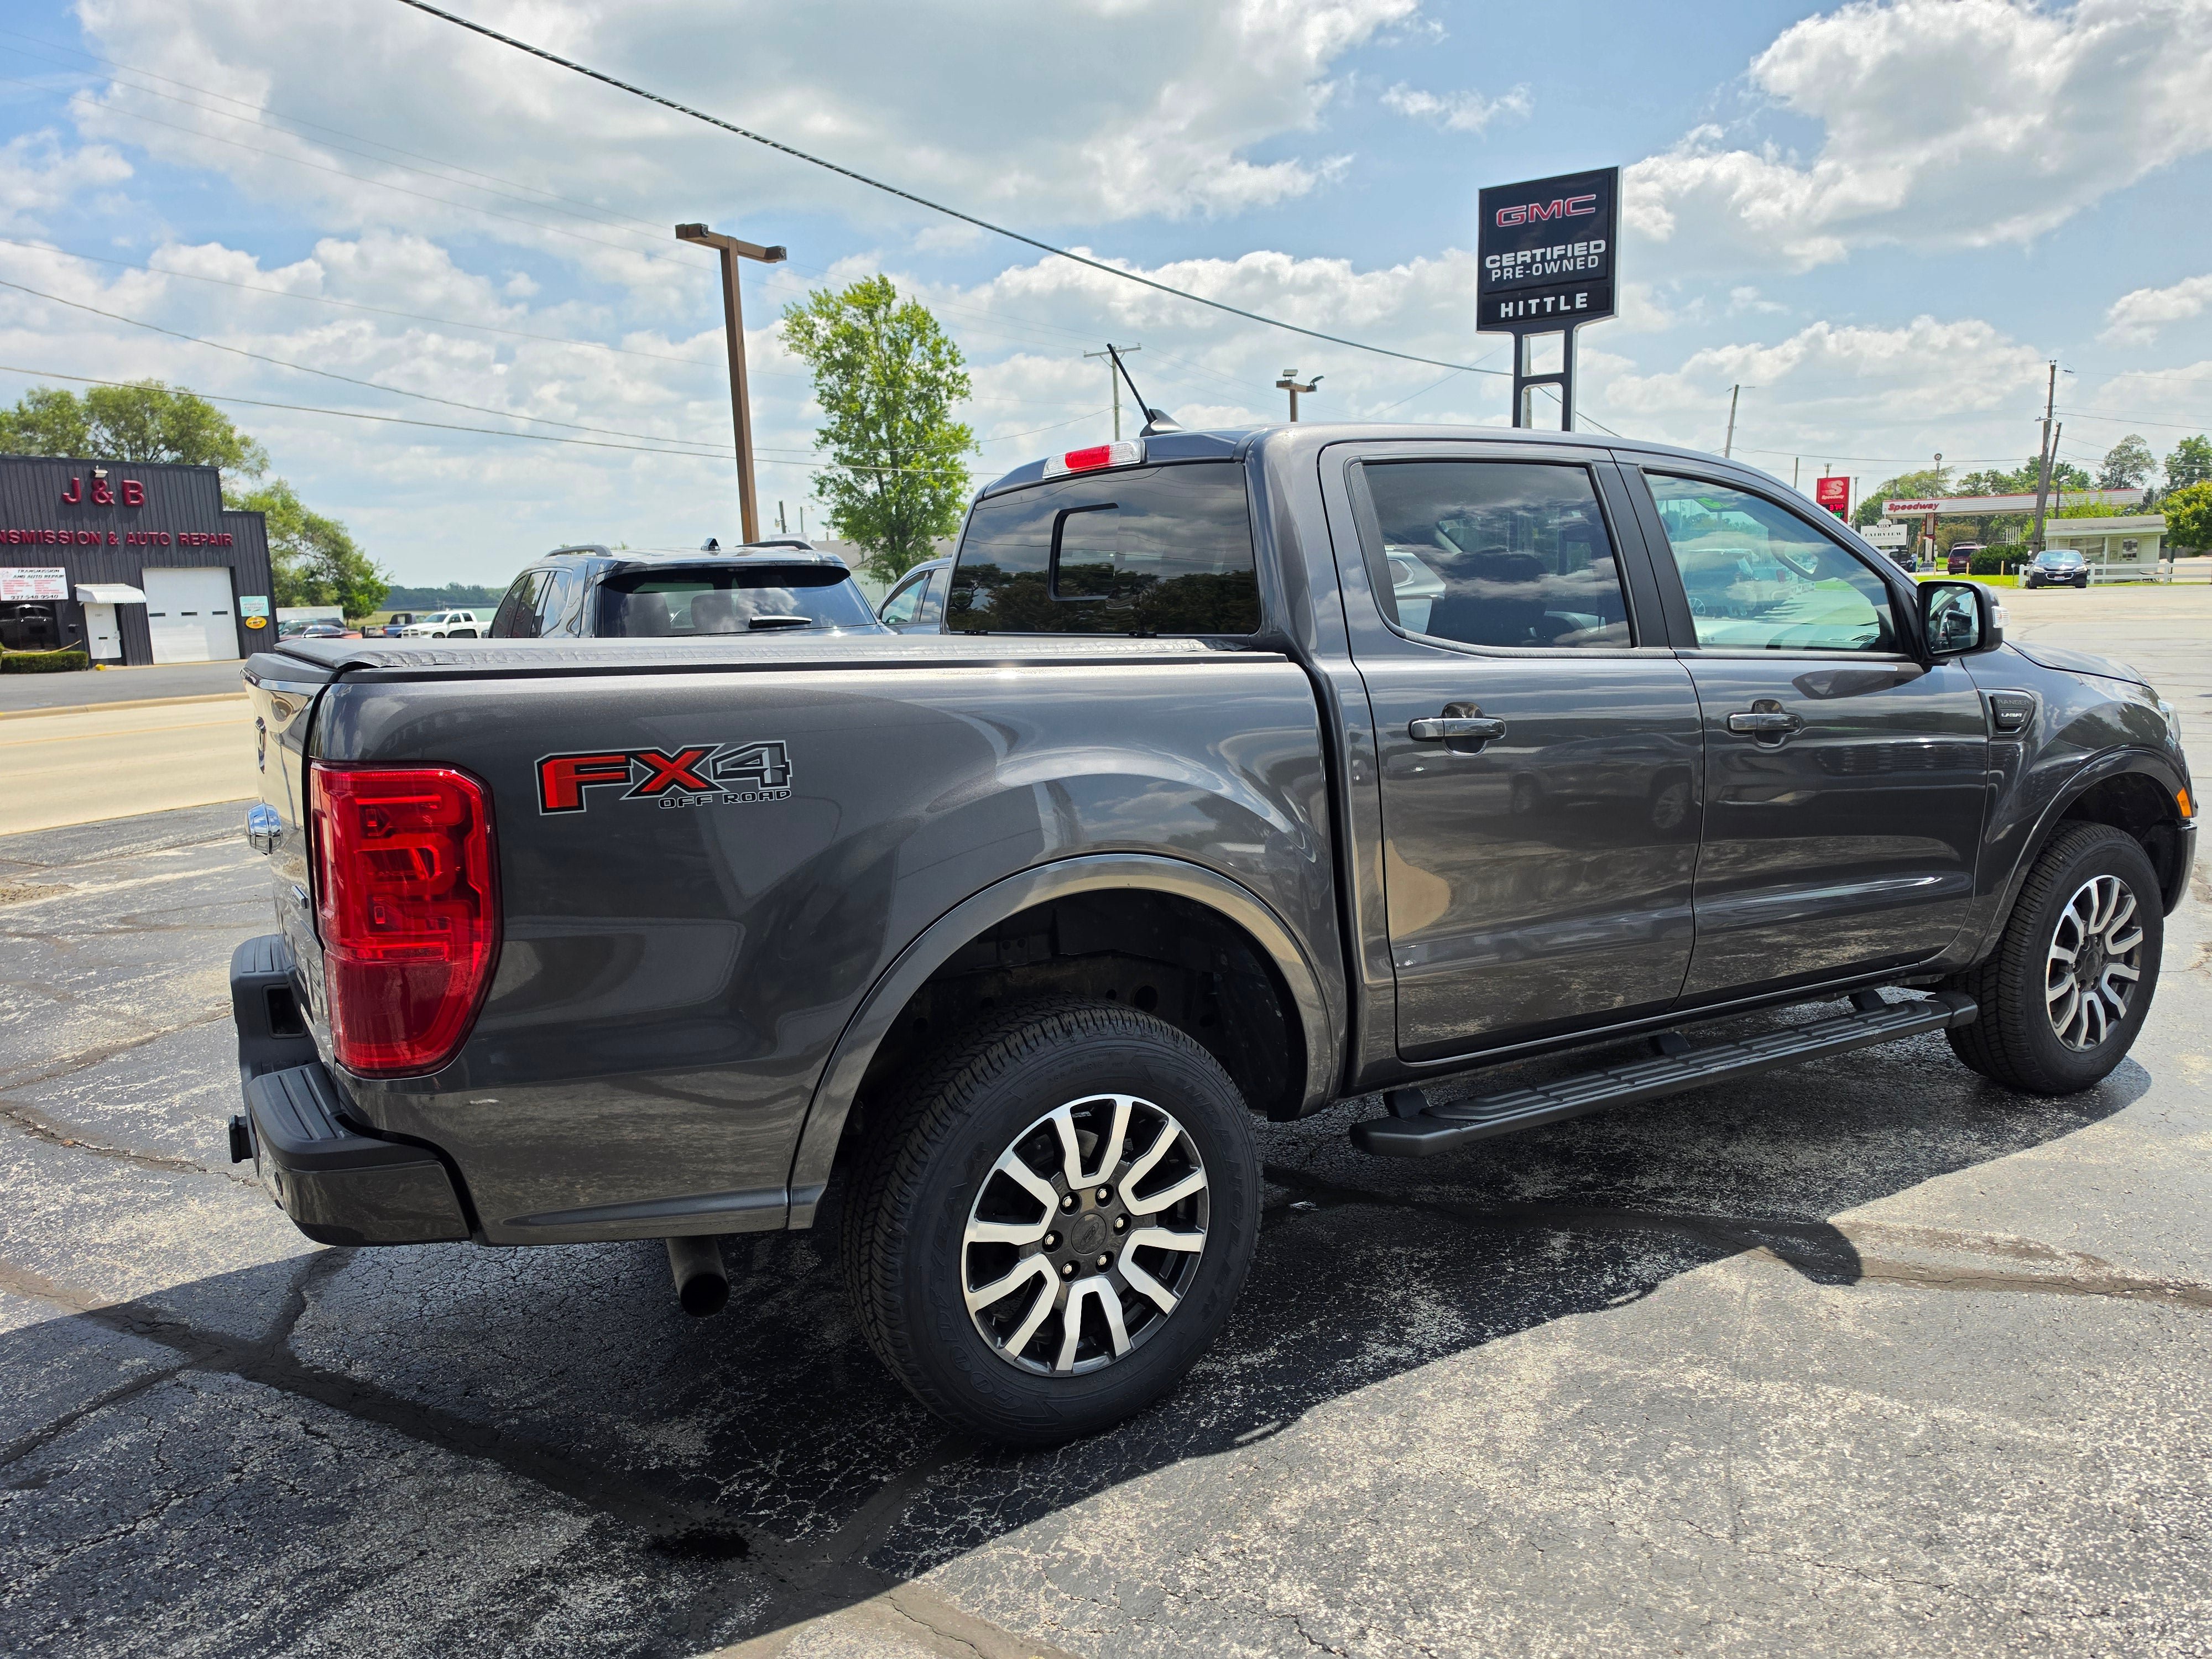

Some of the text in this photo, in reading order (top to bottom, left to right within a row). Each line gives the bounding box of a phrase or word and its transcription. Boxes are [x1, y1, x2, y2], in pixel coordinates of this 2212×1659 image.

[1496, 194, 1597, 227] GMC
[1485, 239, 1606, 269] CERTIFIED
[1491, 255, 1599, 282] PRE-OWNED
[1500, 293, 1588, 318] HITTLE
[62, 477, 145, 507] J & B
[1888, 502, 1940, 513] Speedway
[107, 530, 120, 545] &
[126, 531, 172, 546] AUTO
[178, 532, 233, 546] REPAIR
[535, 740, 793, 816] FX4
[658, 789, 792, 809] OFF ROAD
[1082, 1224, 1097, 1244] Ford
